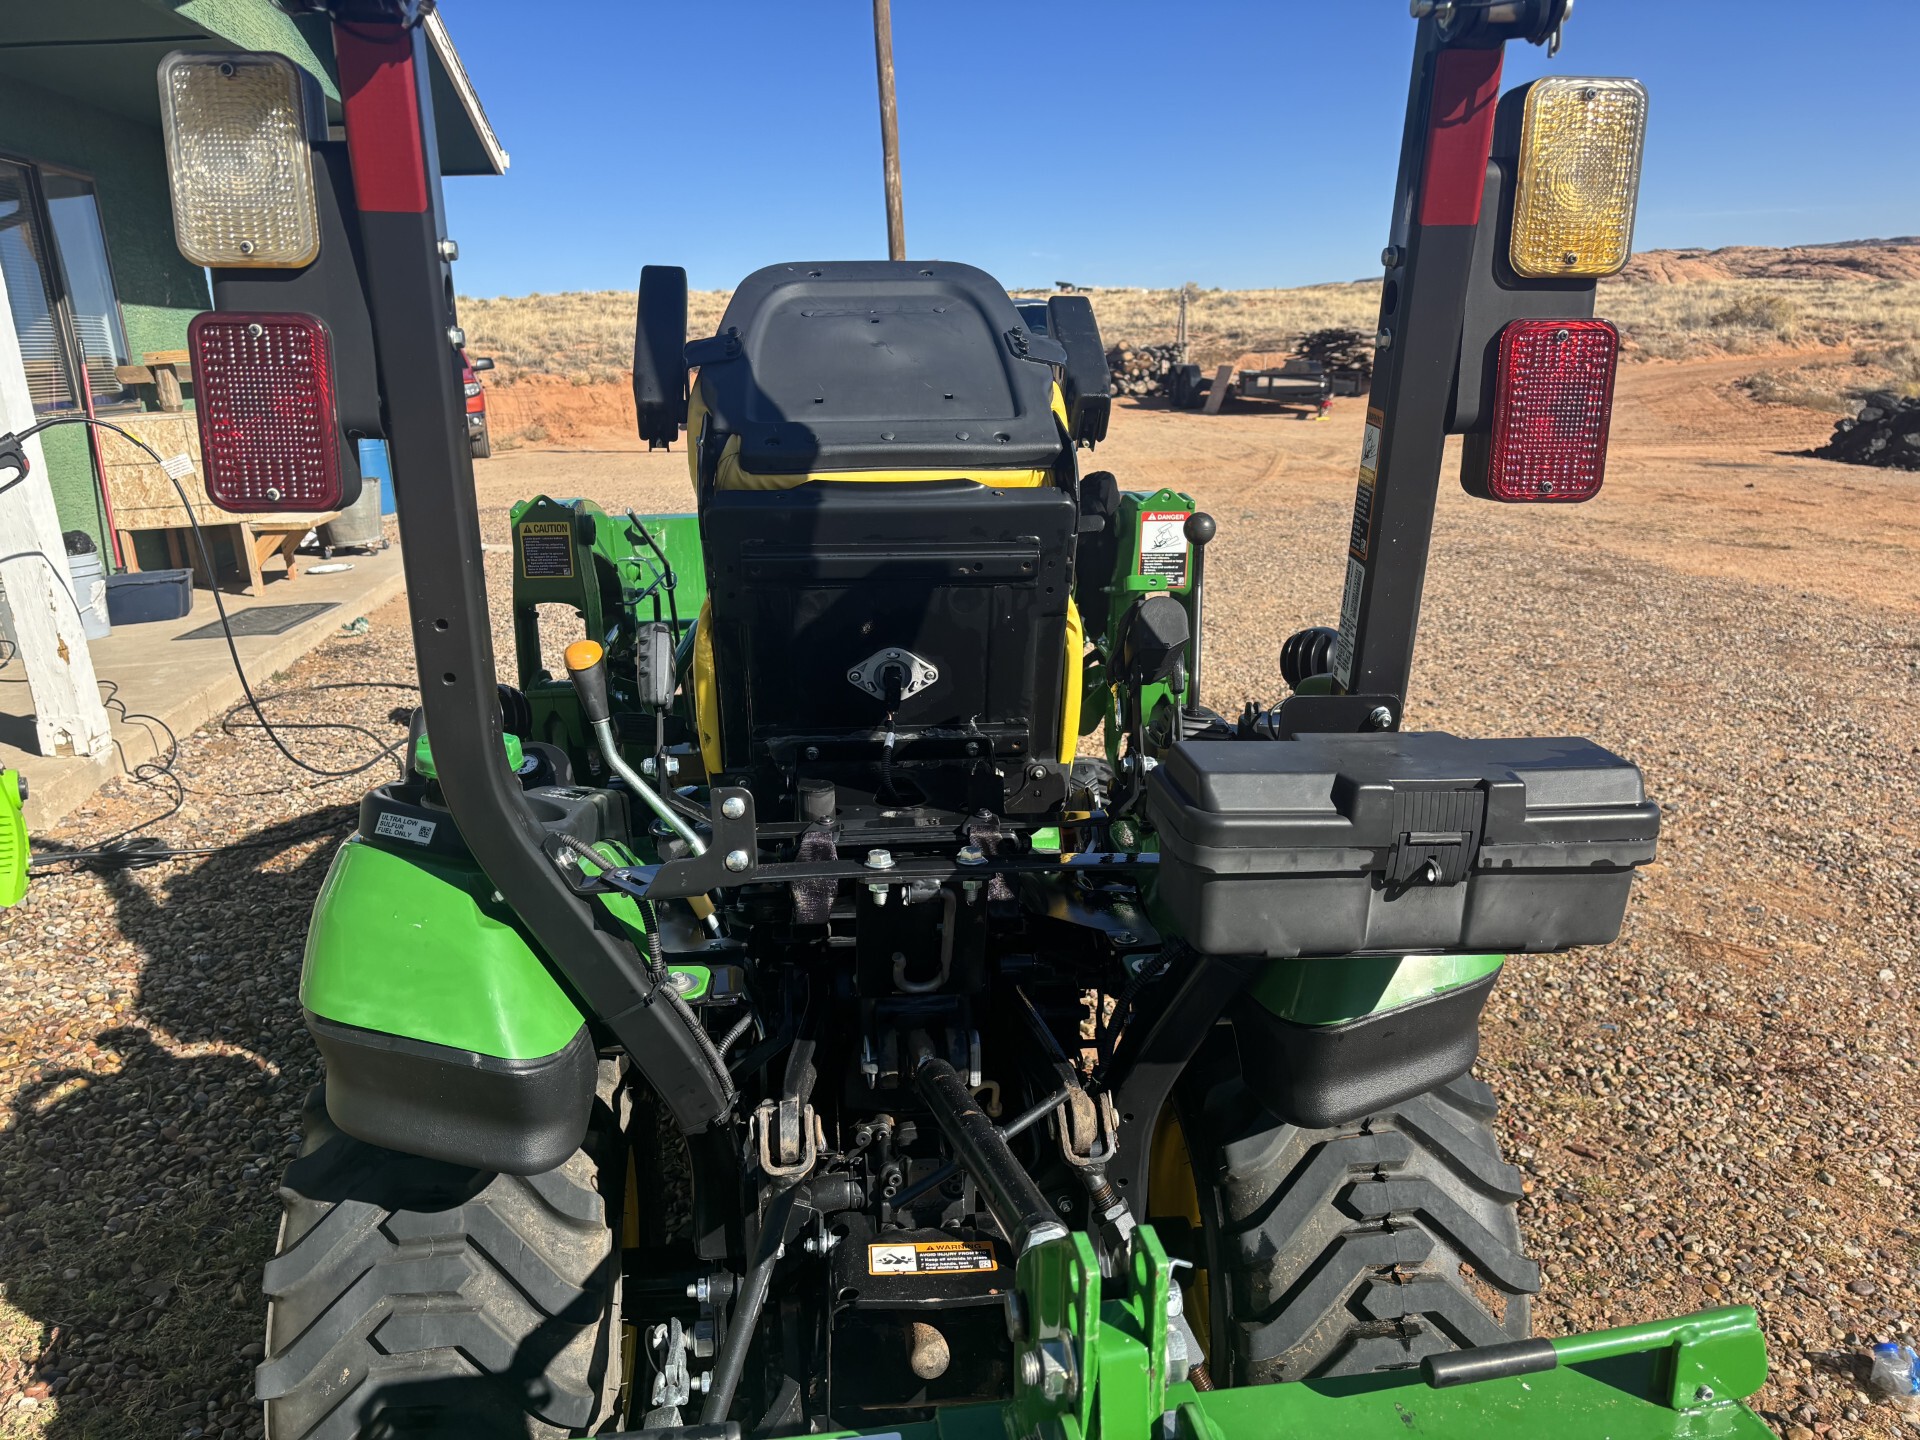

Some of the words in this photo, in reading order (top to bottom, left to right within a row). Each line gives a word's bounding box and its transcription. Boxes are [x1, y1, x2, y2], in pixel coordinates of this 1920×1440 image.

[534, 524, 567, 533] CAUTION
[382, 814, 402, 823] ULTRA
[380, 820, 405, 830] SULFUR
[378, 827, 392, 835] FUEL
[394, 829, 412, 837] ONLY
